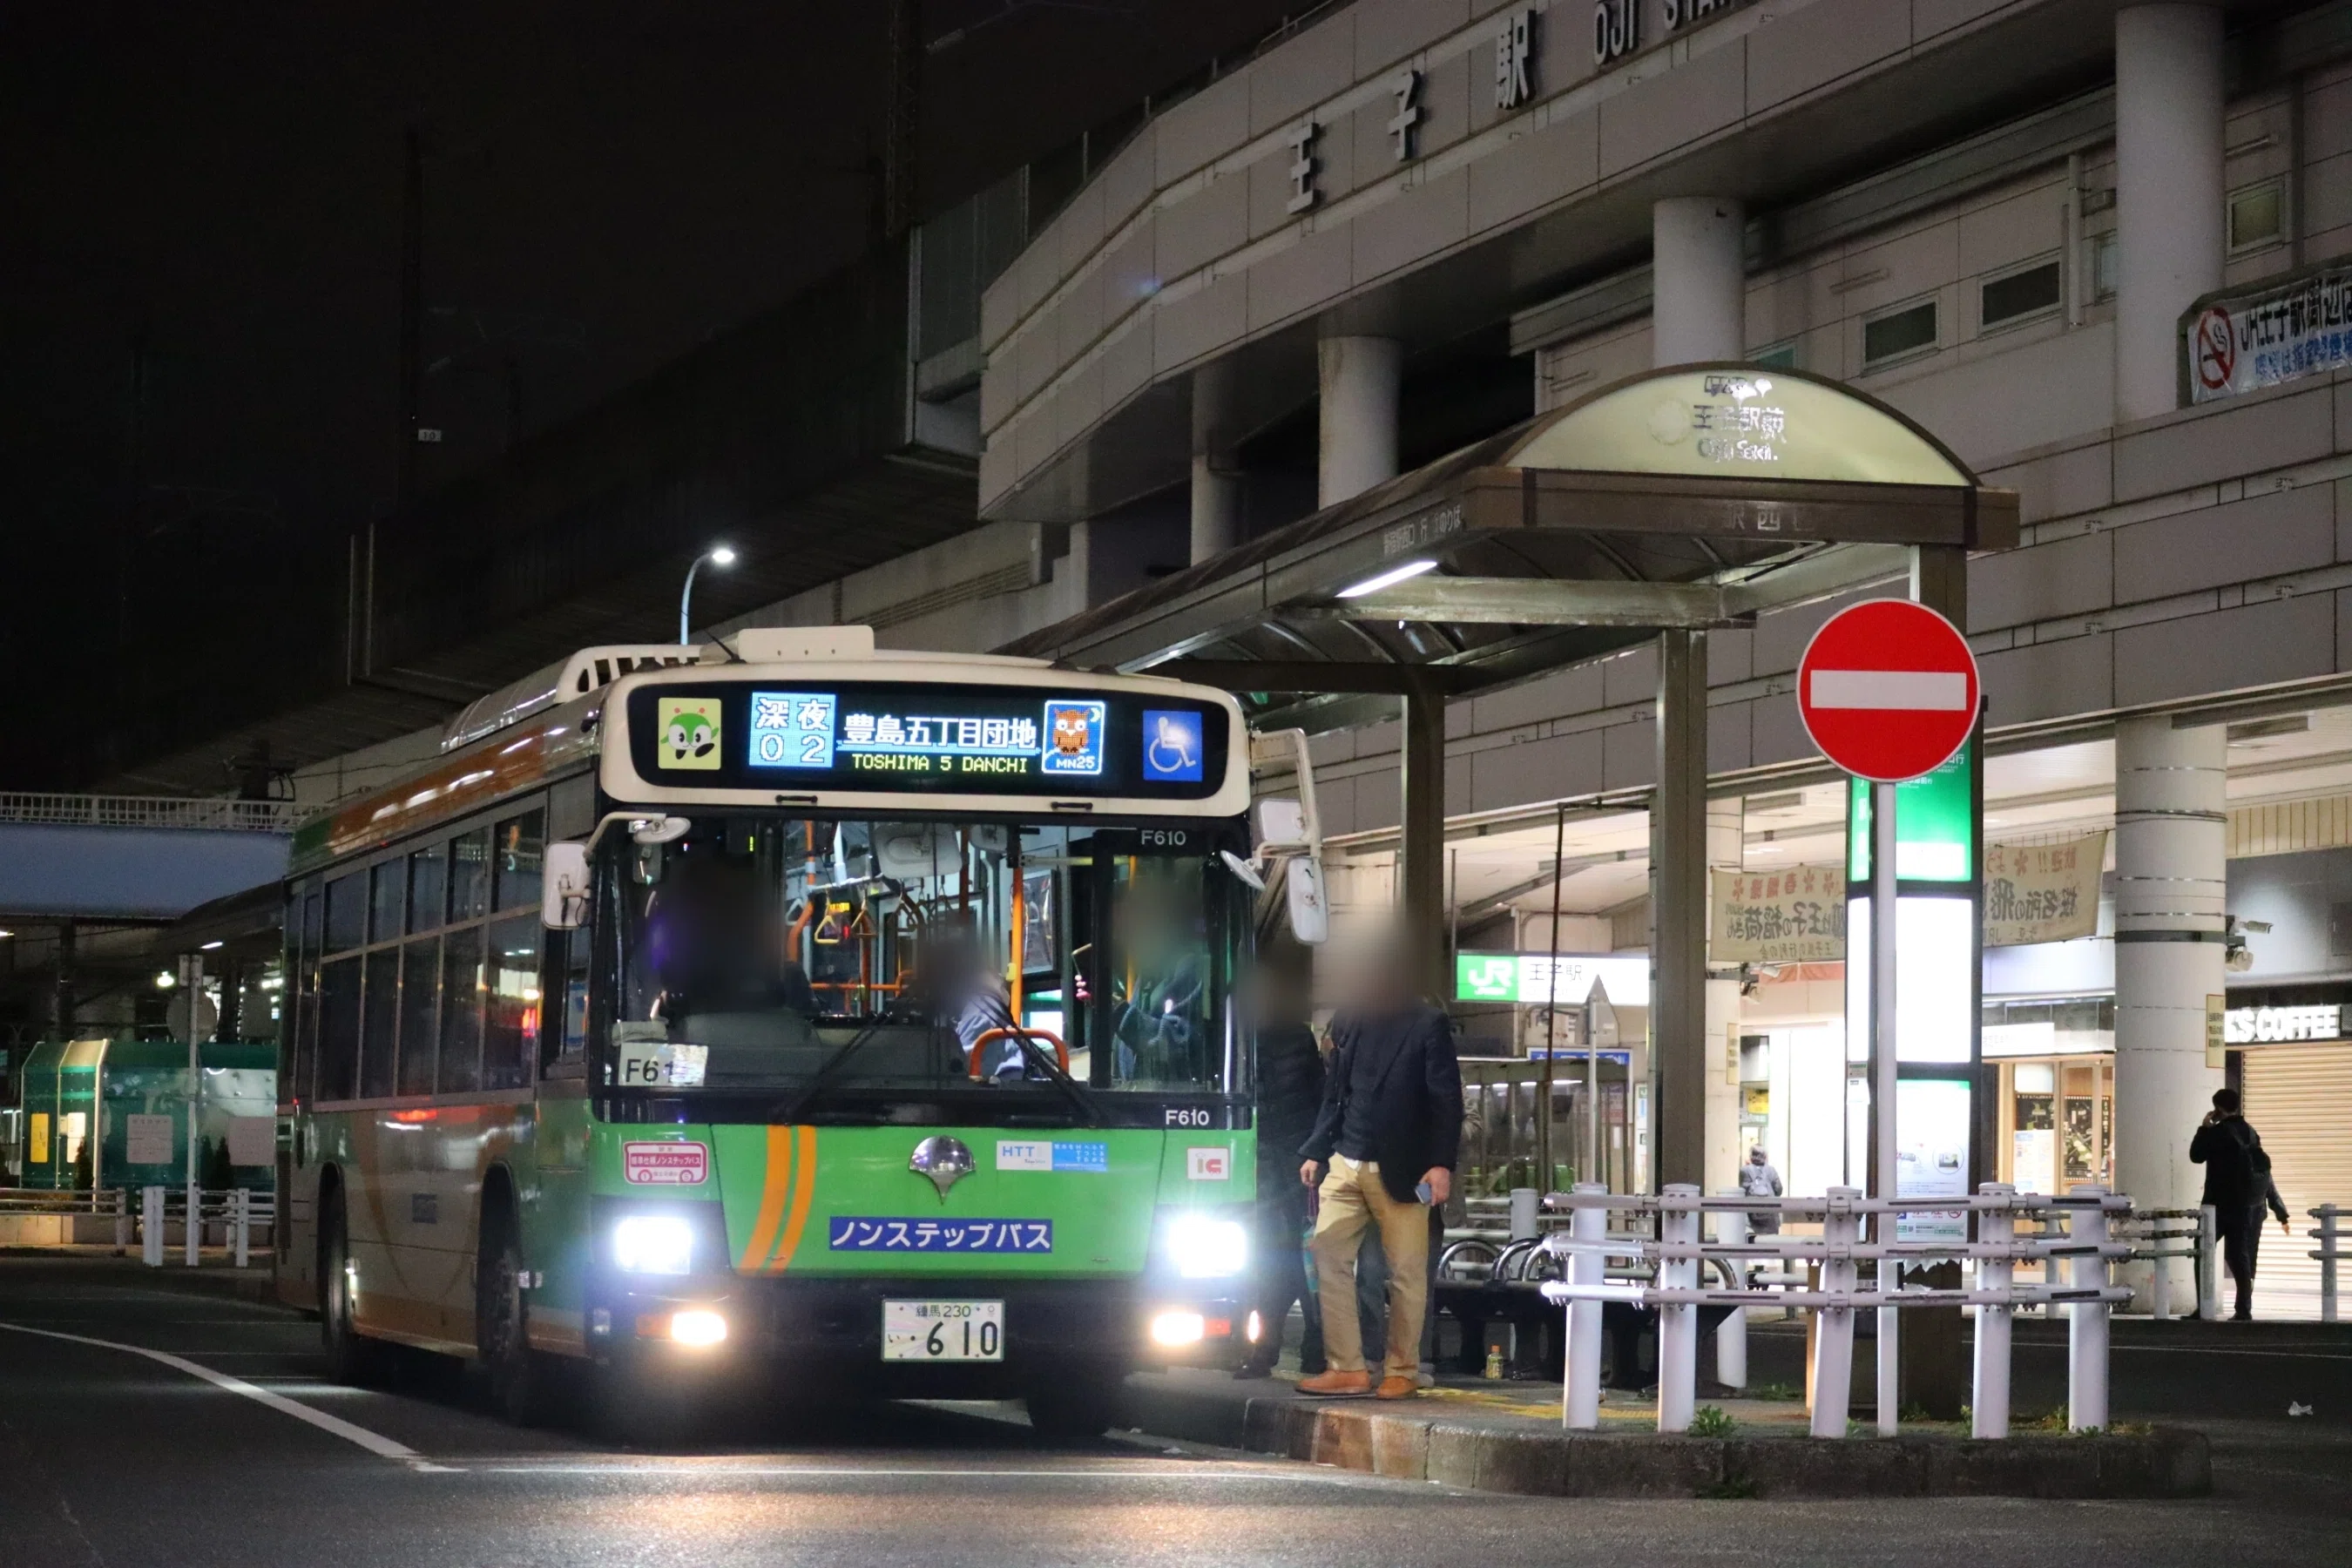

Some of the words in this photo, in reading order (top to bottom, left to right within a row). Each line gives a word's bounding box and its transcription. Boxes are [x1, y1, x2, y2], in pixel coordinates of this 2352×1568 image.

[755, 698, 830, 730] 深夜
[844, 713, 1037, 748] 豊島五丁目団地
[852, 754, 929, 771] TOSHIMA
[940, 755, 951, 771] 5
[962, 756, 1027, 773] DANCHI
[1056, 754, 1095, 769] MN25
[1141, 830, 1186, 846] F610
[1469, 959, 1512, 987] JR
[2256, 1005, 2340, 1042] COFFEE
[1166, 1109, 1209, 1125] F610
[1003, 1146, 1035, 1157] HTT
[832, 1221, 1051, 1248] ノンステップバス
